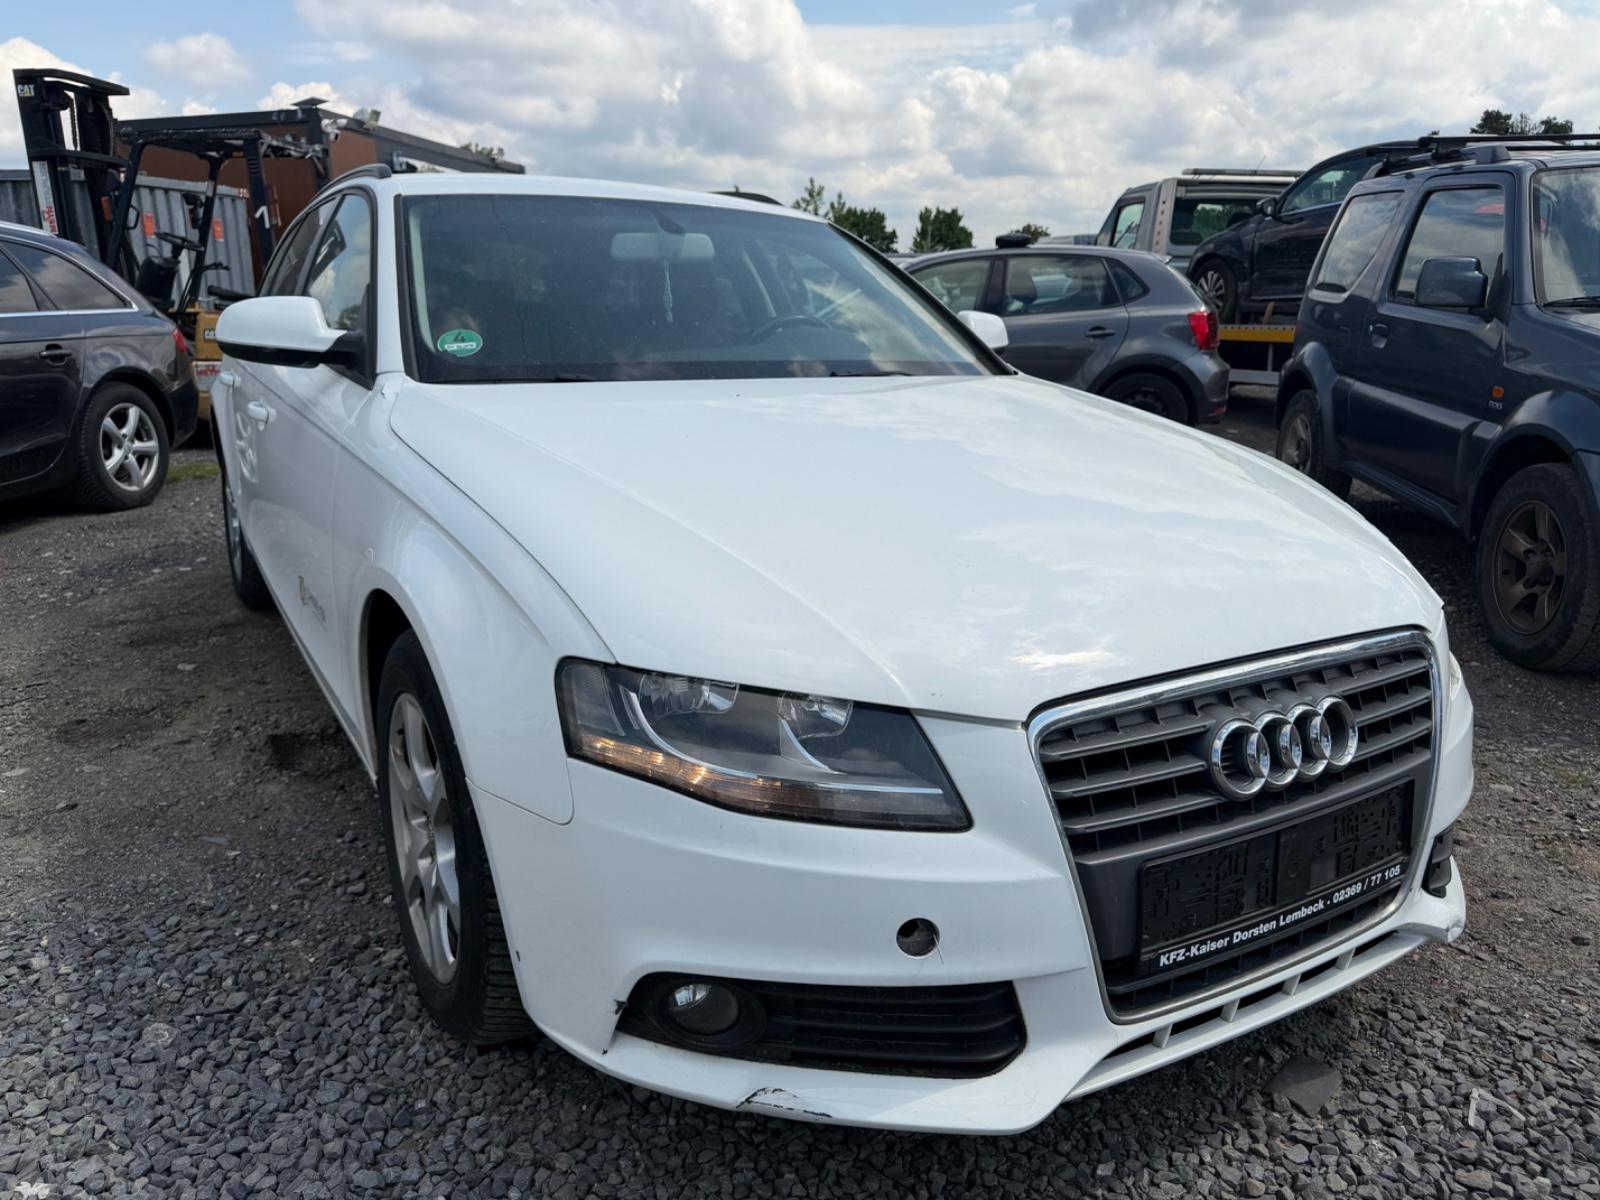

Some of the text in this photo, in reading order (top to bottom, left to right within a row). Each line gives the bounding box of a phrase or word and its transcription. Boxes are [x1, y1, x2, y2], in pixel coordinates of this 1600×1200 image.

[17, 84, 35, 96] CAT
[1159, 937, 1230, 967] KFZ-Kaiser
[1232, 920, 1277, 944] Dorsten
[1279, 899, 1324, 926] Lembeck
[1333, 882, 1362, 904] 02369
[1370, 873, 1382, 887] 77
[1384, 864, 1400, 880] 105
